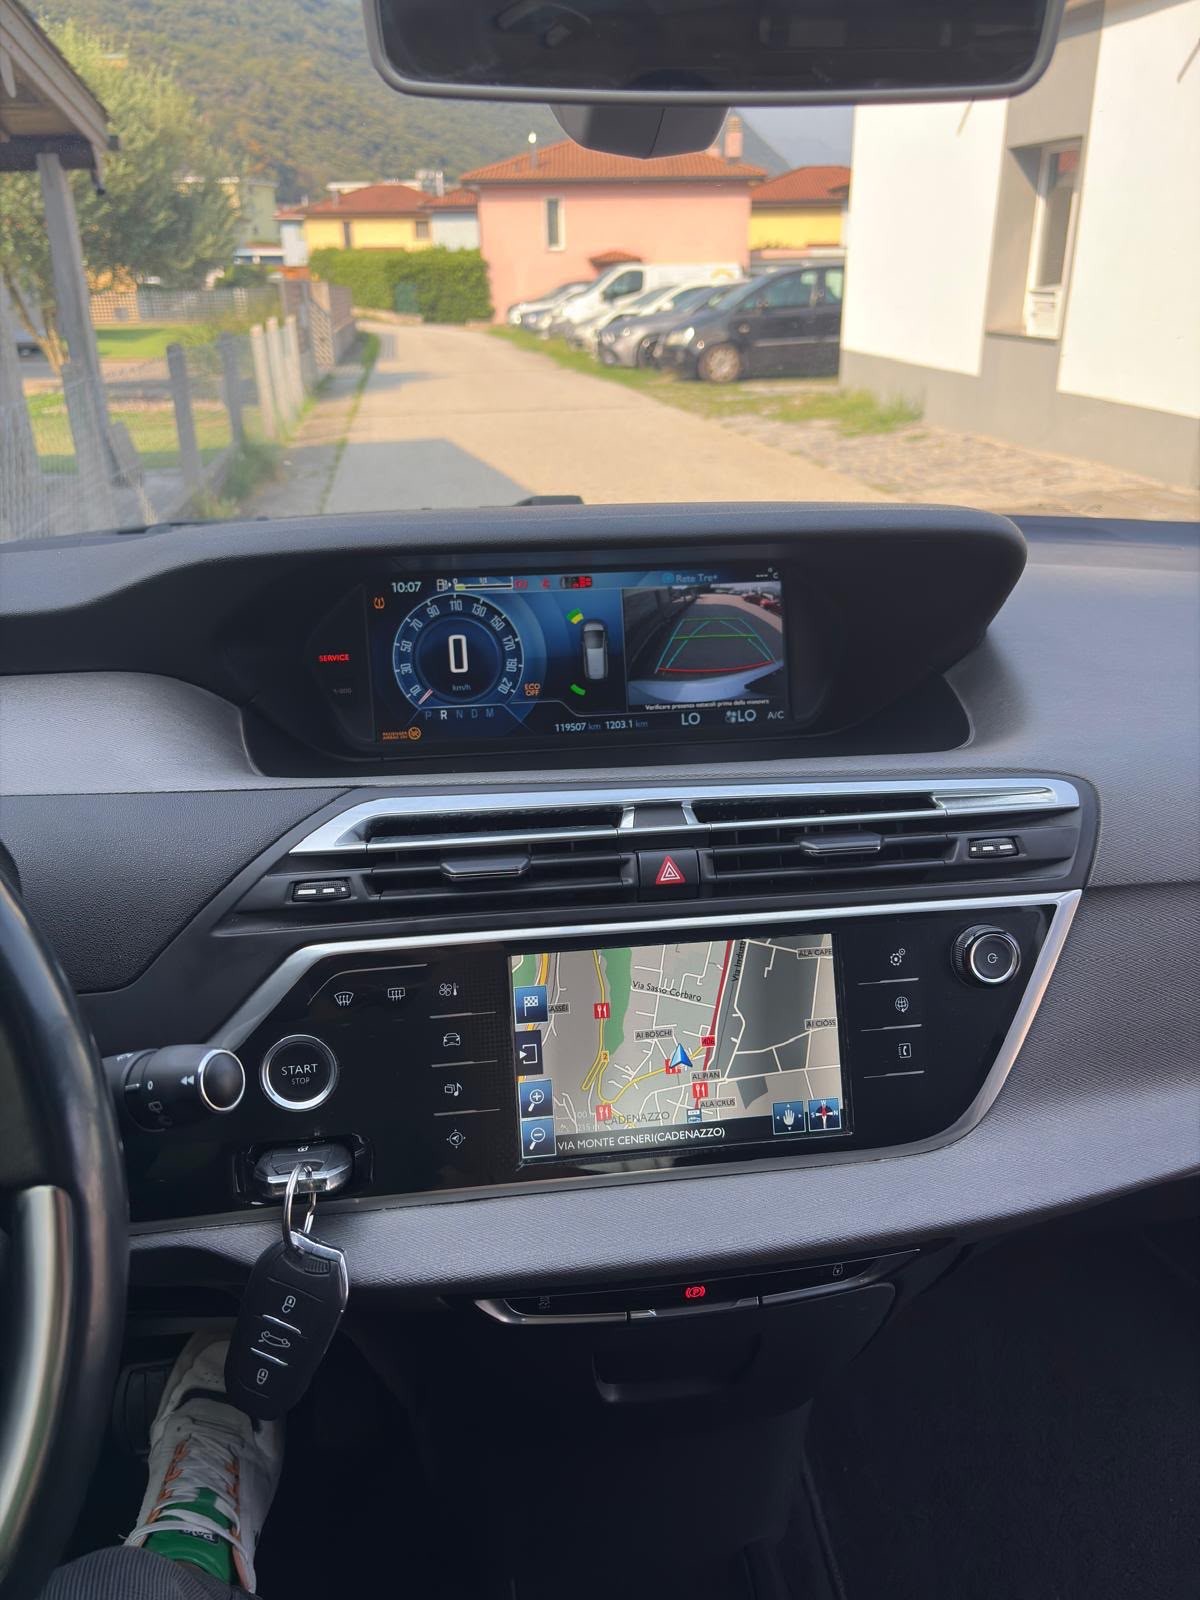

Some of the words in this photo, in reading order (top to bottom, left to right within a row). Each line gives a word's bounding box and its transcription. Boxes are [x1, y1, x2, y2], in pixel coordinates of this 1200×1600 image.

[391, 581, 422, 593] 10:07
[426, 605, 440, 618] 90
[450, 600, 463, 612] 110
[472, 603, 487, 618] 130
[410, 620, 424, 632] 70
[490, 615, 505, 632] 150
[400, 640, 412, 653] 50
[502, 635, 516, 652] 170
[318, 654, 350, 662] SERVICE
[448, 634, 468, 674] 0
[400, 664, 412, 675] 30
[506, 658, 518, 673] 190
[409, 684, 421, 696] 10
[497, 678, 513, 695] 210
[440, 709, 448, 720] R
[681, 712, 701, 726] LO
[737, 710, 756, 722] LO
[768, 710, 784, 720] A/C
[555, 722, 586, 732] 119507
[588, 722, 602, 730] km
[605, 720, 633, 730] 1203.1
[632, 980, 645, 990] Via
[646, 983, 668, 994] Sasso
[669, 987, 702, 1002] Corbaro
[646, 1030, 673, 1038] BOSCHI
[281, 1062, 318, 1076] START
[291, 1076, 310, 1086] STOP
[603, 1111, 670, 1126] CADENAZZO
[558, 1142, 575, 1151] VIA
[577, 1138, 615, 1148] MONTE
[618, 1128, 726, 1146] CENERI(CADENAZZO)
